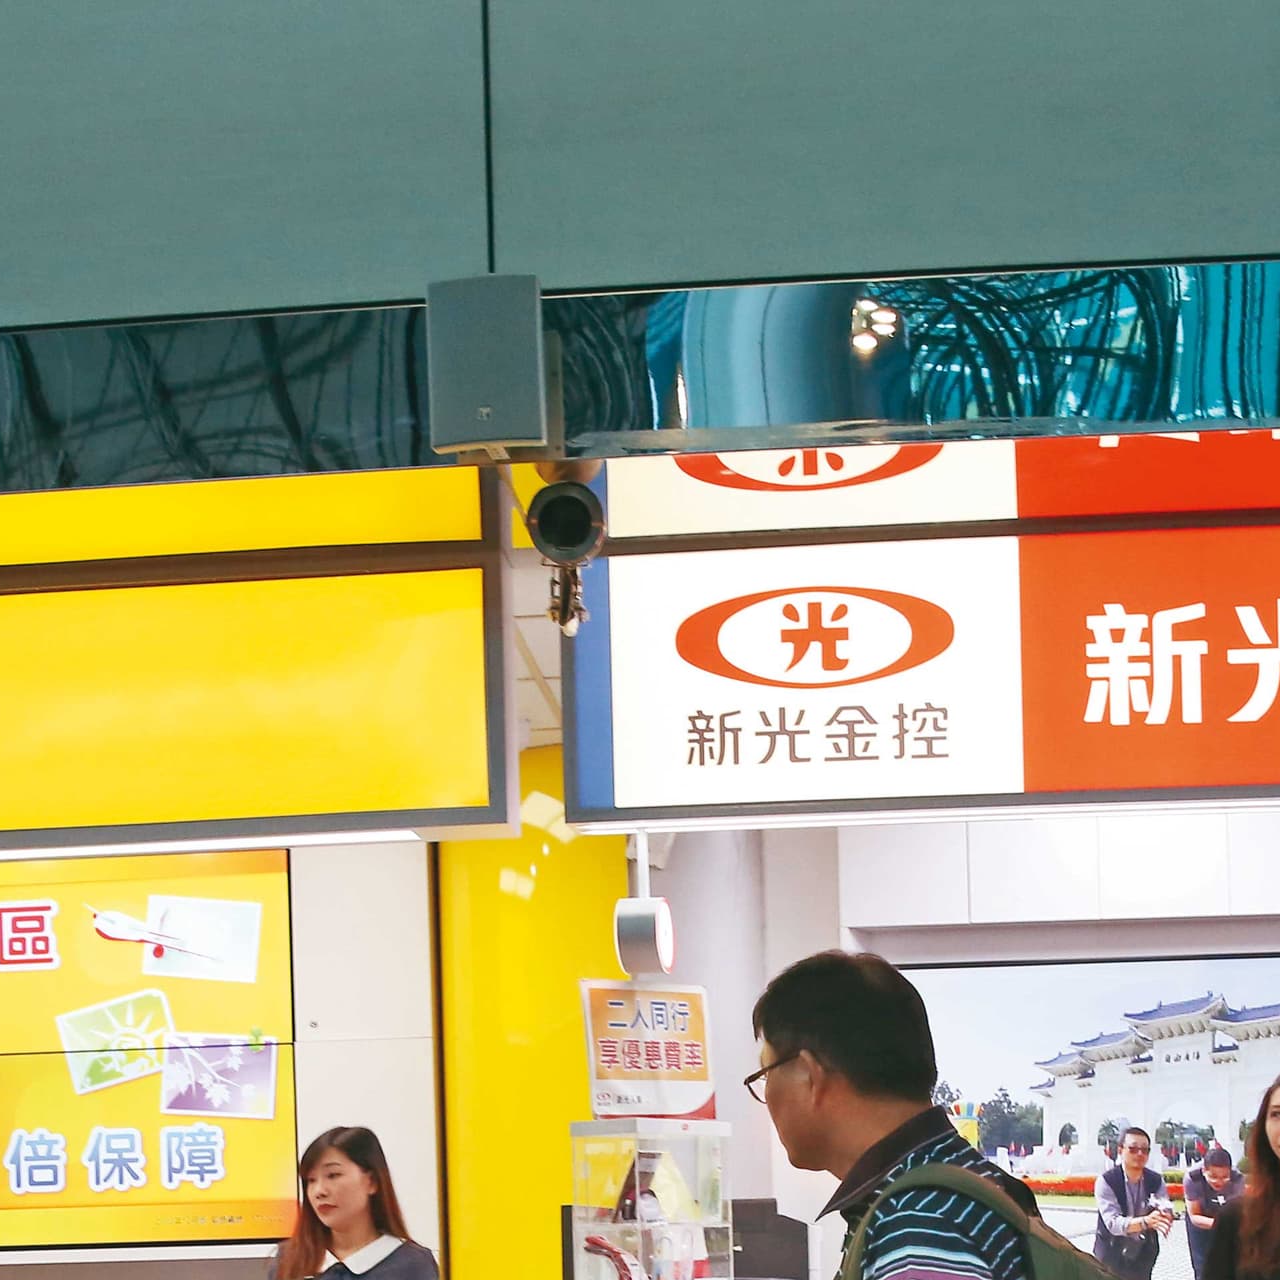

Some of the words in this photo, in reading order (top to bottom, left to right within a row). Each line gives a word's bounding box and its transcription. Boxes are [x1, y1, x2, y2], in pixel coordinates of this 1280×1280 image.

[780, 602, 850, 672] 光
[686, 702, 950, 767] 新光金控
[608, 1000, 689, 1031] 二人同行
[598, 1040, 703, 1071] 享優惠費率
